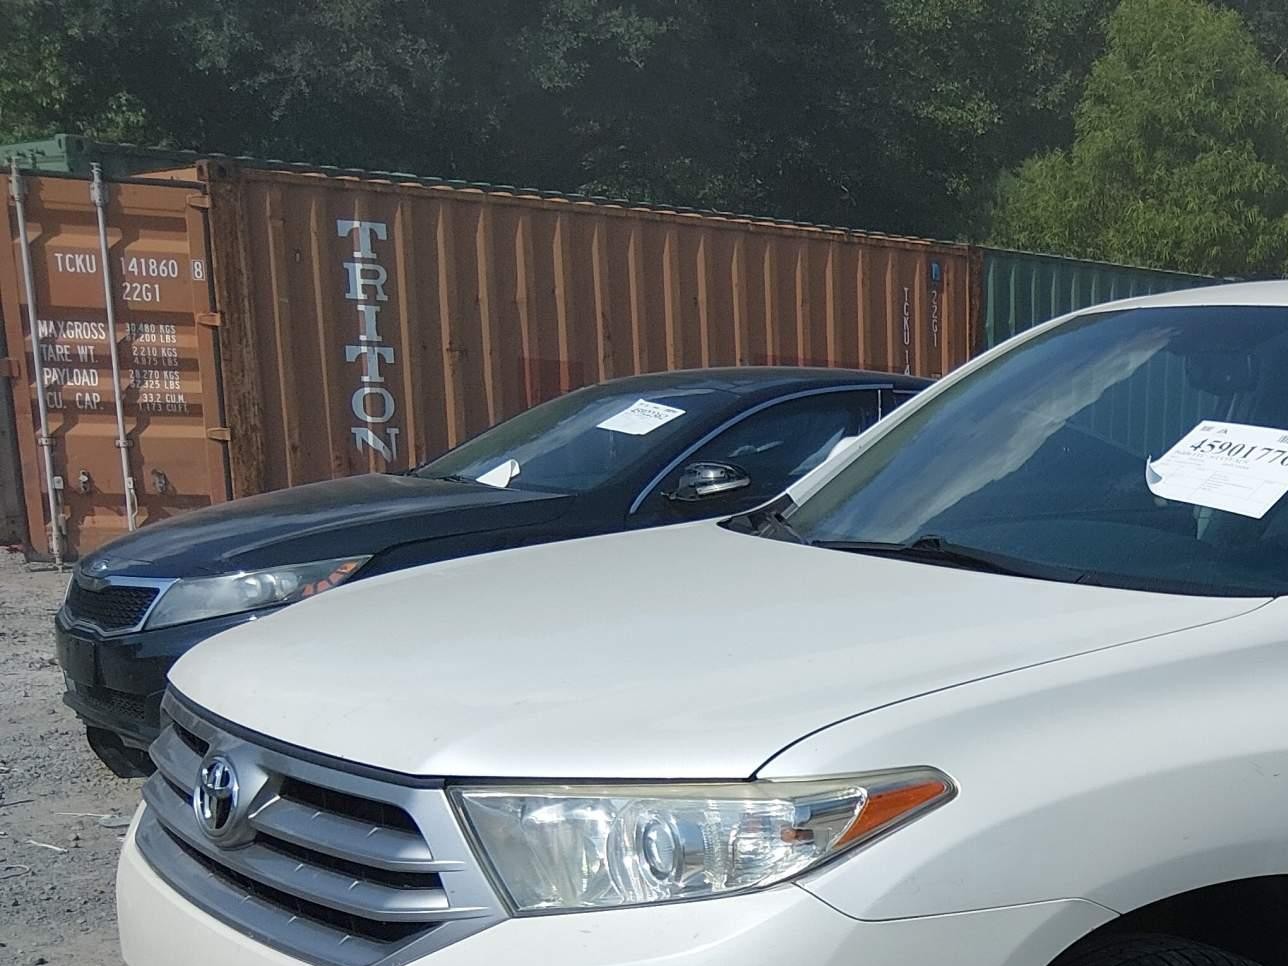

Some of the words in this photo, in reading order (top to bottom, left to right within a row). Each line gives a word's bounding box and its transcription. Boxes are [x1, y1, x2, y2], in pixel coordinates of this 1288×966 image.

[54, 253, 97, 273] TCKU
[120, 257, 178, 278] 141860
[193, 261, 204, 279] 8
[122, 282, 160, 302] 22G1
[160, 324, 177, 335] KGS
[160, 334, 177, 344] LBS
[336, 219, 400, 464] TRITON
[40, 344, 72, 362] TARE
[77, 345, 99, 363] WT.
[161, 347, 178, 358] KGS
[43, 367, 99, 387] PAYLOAD
[163, 370, 180, 381] KGS
[164, 380, 181, 390] LBS
[47, 391, 67, 409] CU.
[76, 392, 104, 410] CAP.
